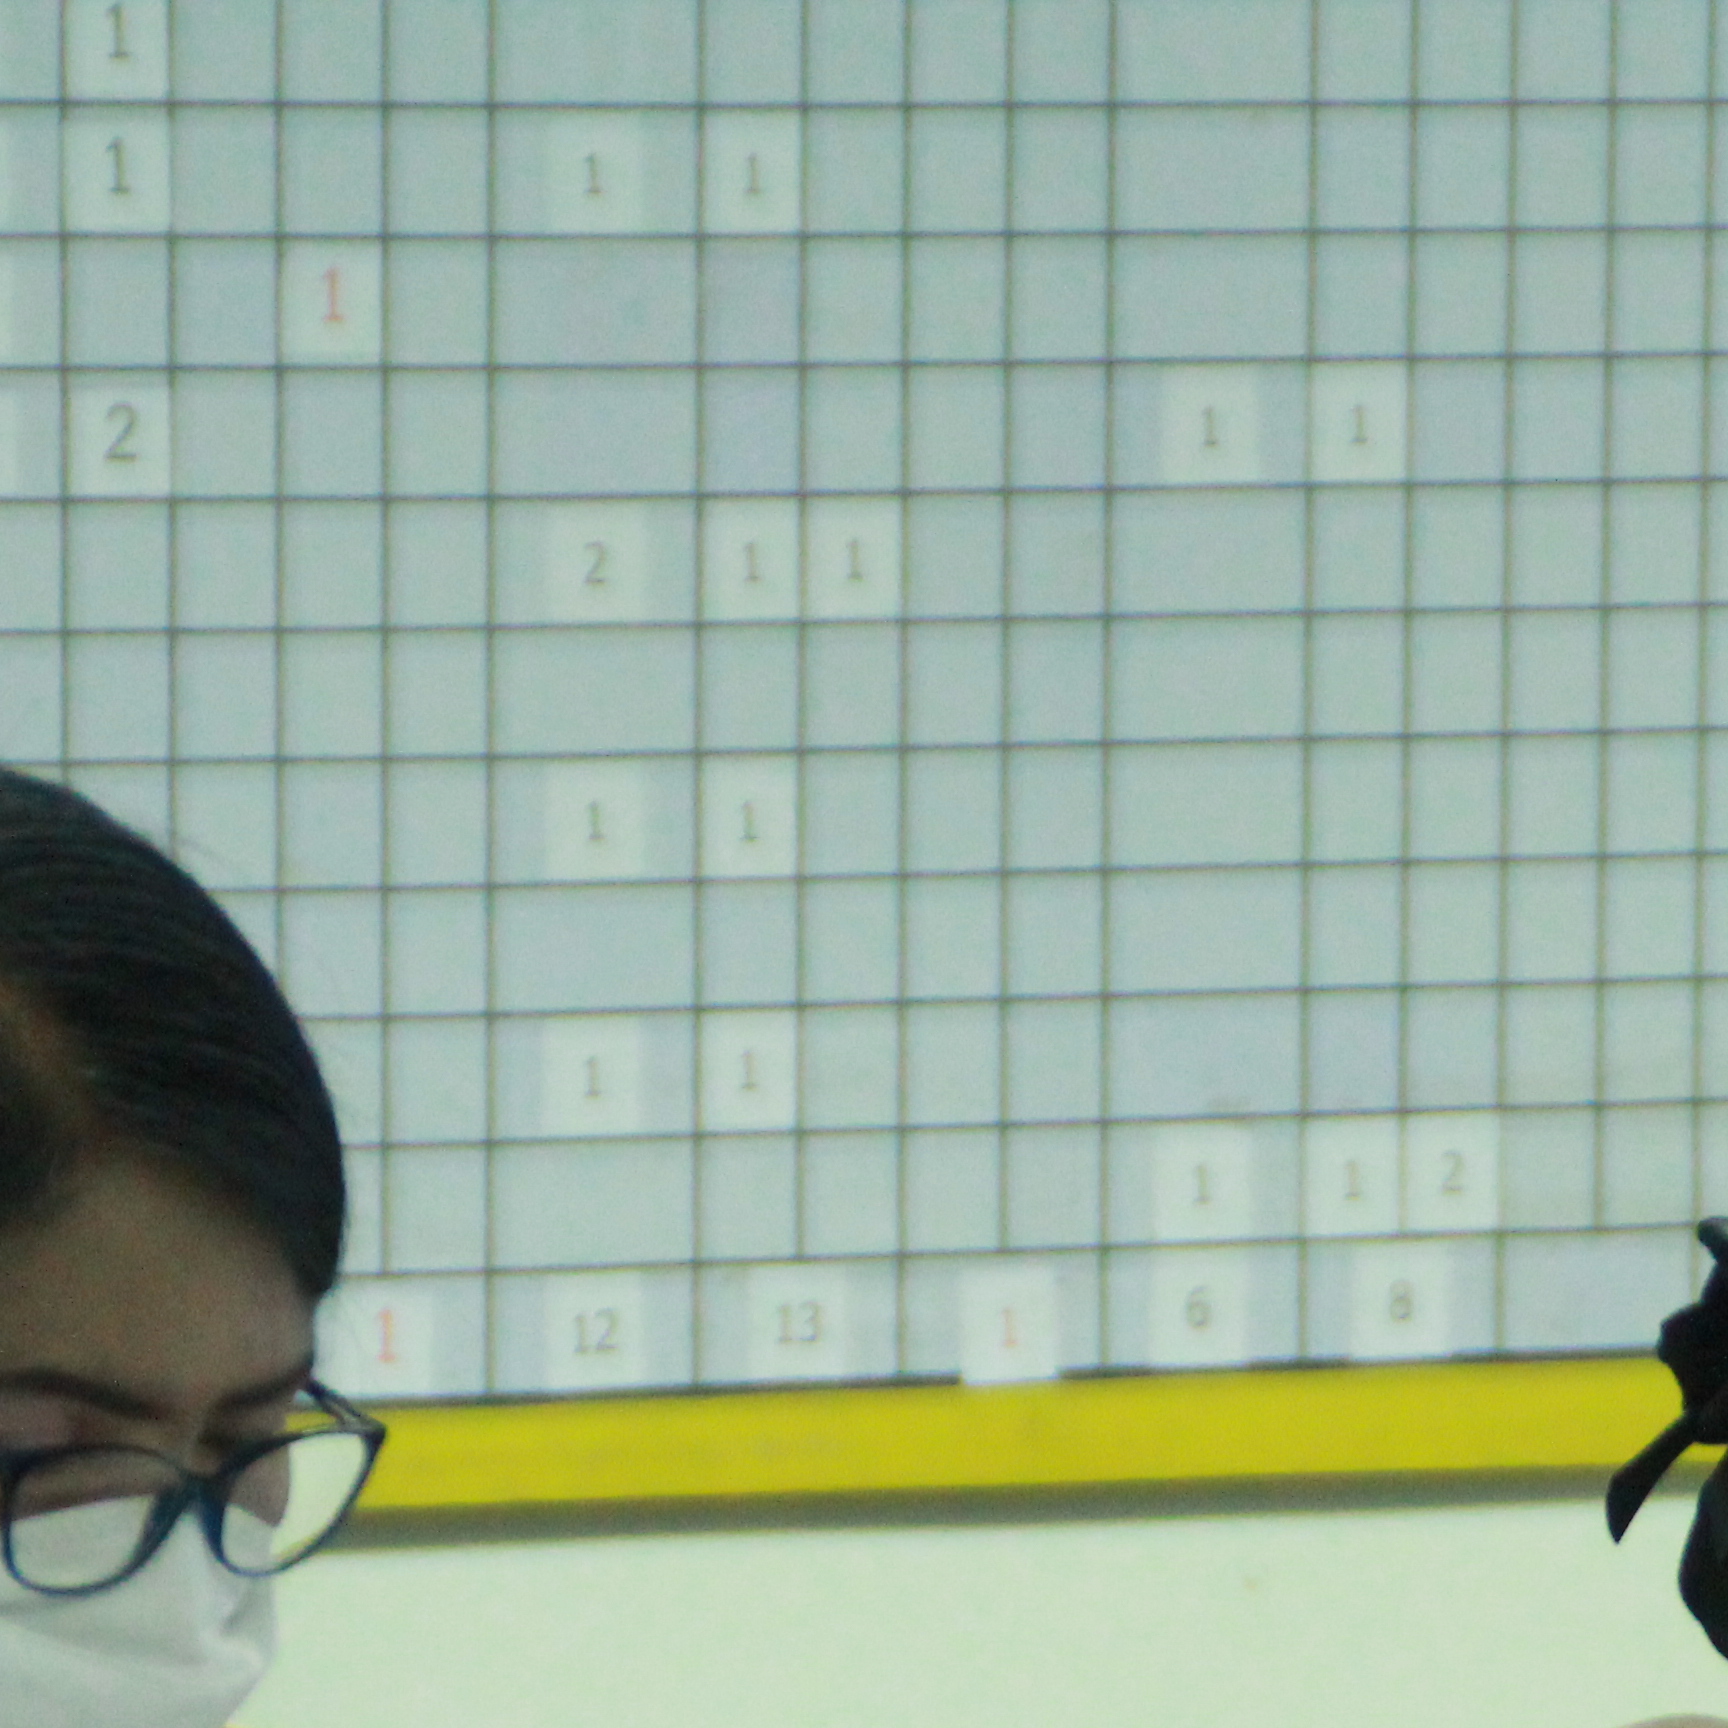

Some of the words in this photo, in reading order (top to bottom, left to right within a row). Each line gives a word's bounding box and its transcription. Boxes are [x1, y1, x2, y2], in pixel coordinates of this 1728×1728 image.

[107, 0, 131, 63] 1
[106, 136, 132, 198] 1
[584, 153, 604, 199] 1
[744, 153, 766, 200] 1
[321, 266, 345, 326] 1
[105, 402, 139, 465] 2
[1202, 406, 1221, 452] 1
[1350, 404, 1370, 448] 1
[584, 541, 610, 591] 2
[743, 541, 764, 587] 1
[846, 538, 866, 585] 1
[586, 800, 607, 846] 1
[740, 801, 760, 846] 1
[583, 1055, 604, 1102] 1
[739, 1050, 760, 1094] 1
[1193, 1162, 1214, 1208] 1
[1343, 1159, 1366, 1204] 1
[1440, 1149, 1466, 1199] 2
[376, 1307, 399, 1366] 1
[572, 1307, 620, 1357] 12
[775, 1299, 825, 1346] 13
[999, 1305, 1020, 1350] 1
[1184, 1284, 1213, 1332] 6
